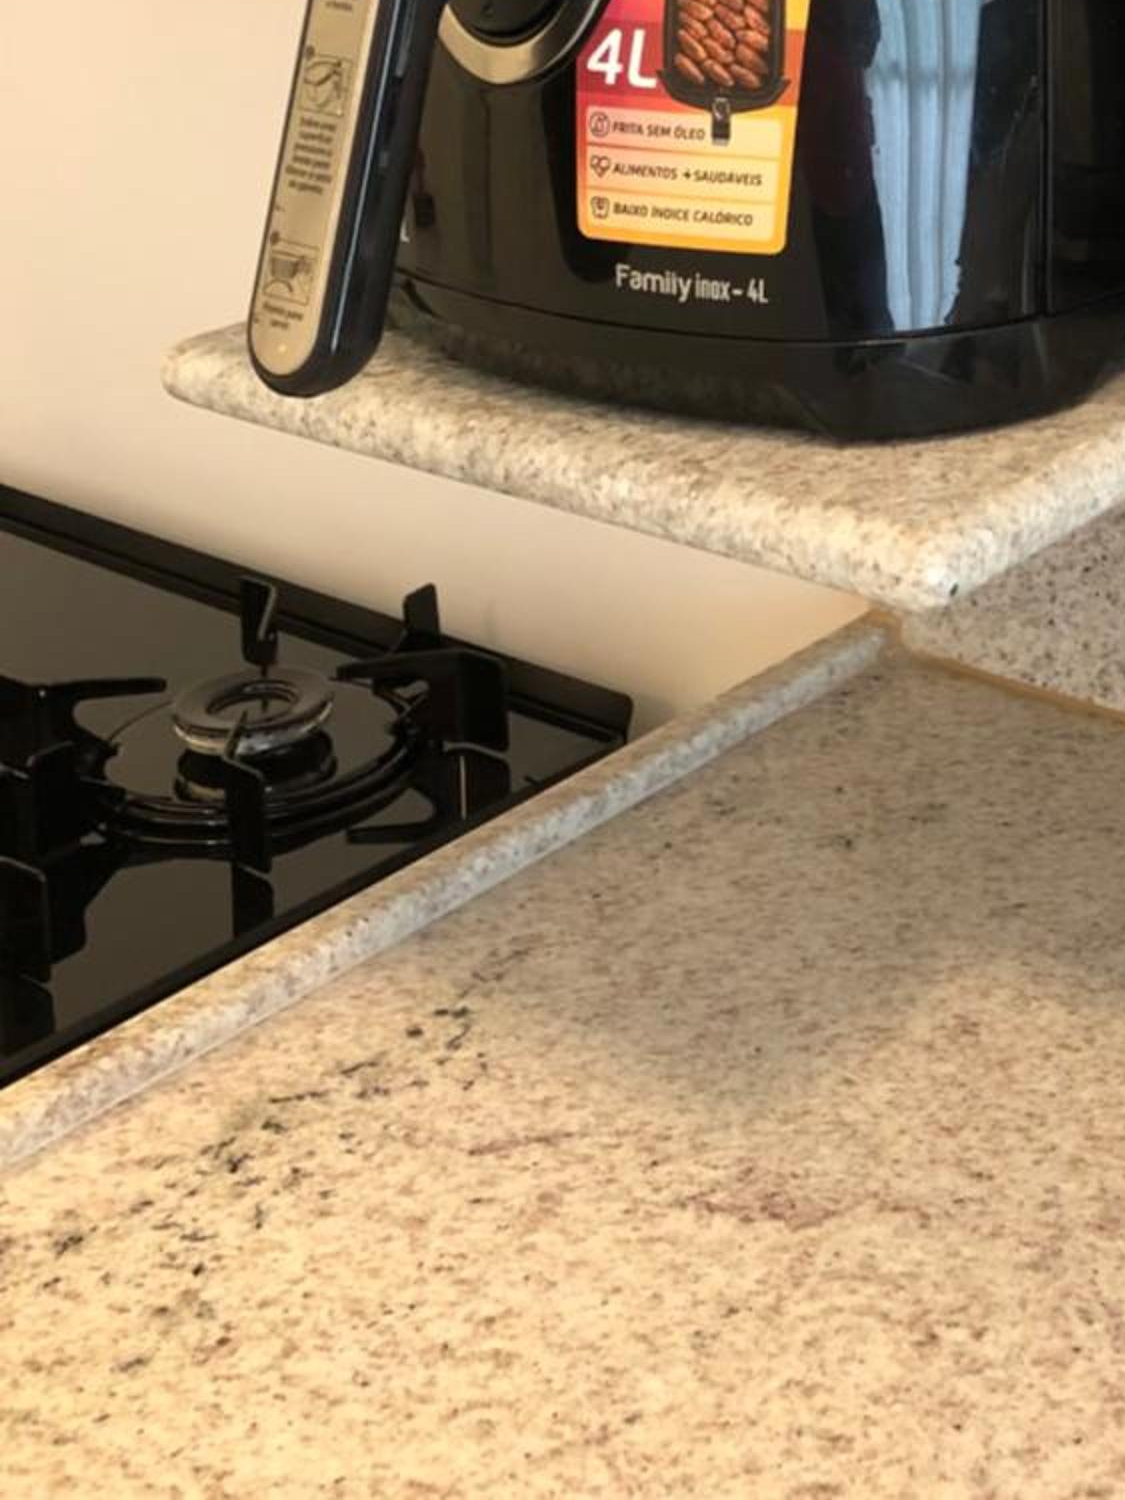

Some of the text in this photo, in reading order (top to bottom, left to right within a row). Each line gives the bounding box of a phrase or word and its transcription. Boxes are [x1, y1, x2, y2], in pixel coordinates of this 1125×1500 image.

[586, 28, 657, 88] 4L
[613, 120, 643, 135] FRITA
[645, 123, 671, 138] SEM
[612, 162, 678, 180] ALIMENTOS
[613, 202, 648, 217] BAIXO
[614, 262, 692, 303] Family
[694, 272, 731, 301] inox
[747, 278, 769, 304] 4L
